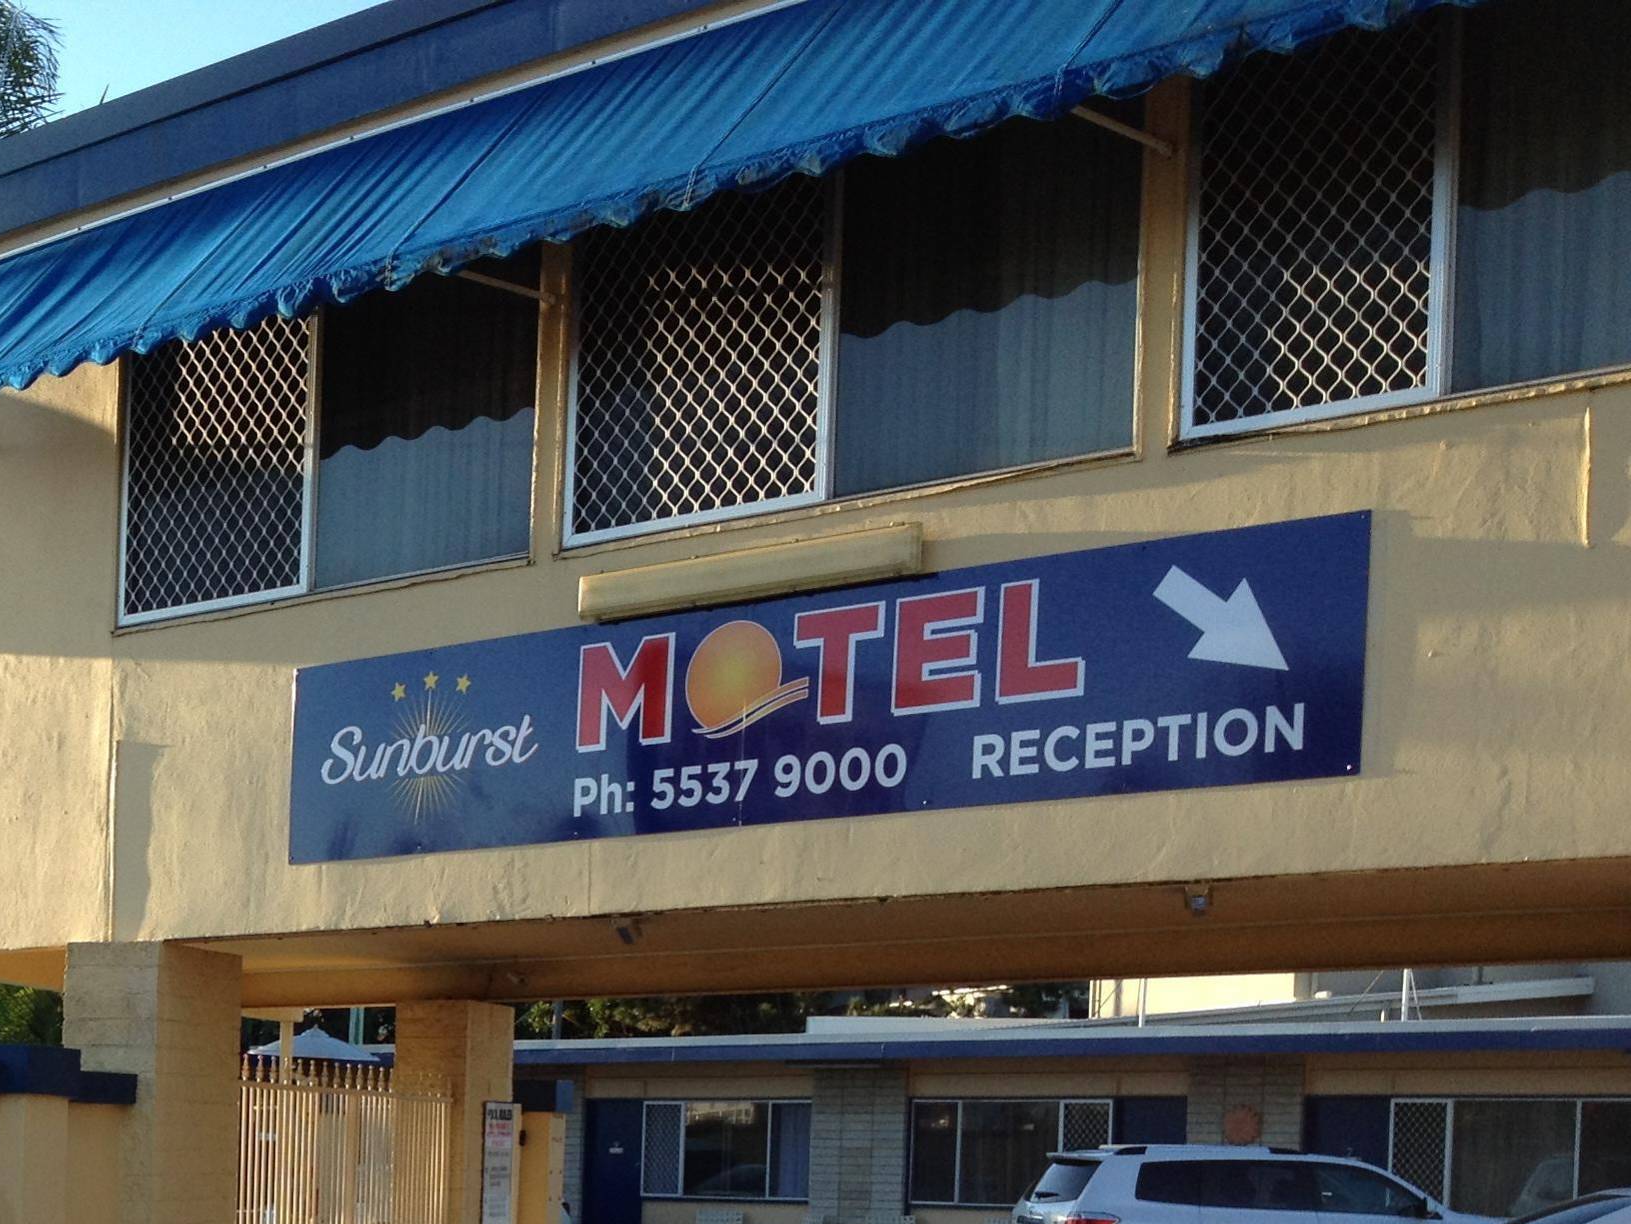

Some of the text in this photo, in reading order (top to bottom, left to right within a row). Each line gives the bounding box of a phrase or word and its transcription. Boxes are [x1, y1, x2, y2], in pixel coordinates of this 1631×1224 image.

[575, 576, 1086, 752] MOTEL
[320, 713, 539, 786] Sunburst
[971, 703, 1307, 779] RECEPTION
[573, 743, 908, 817] Ph: 5537 9000
